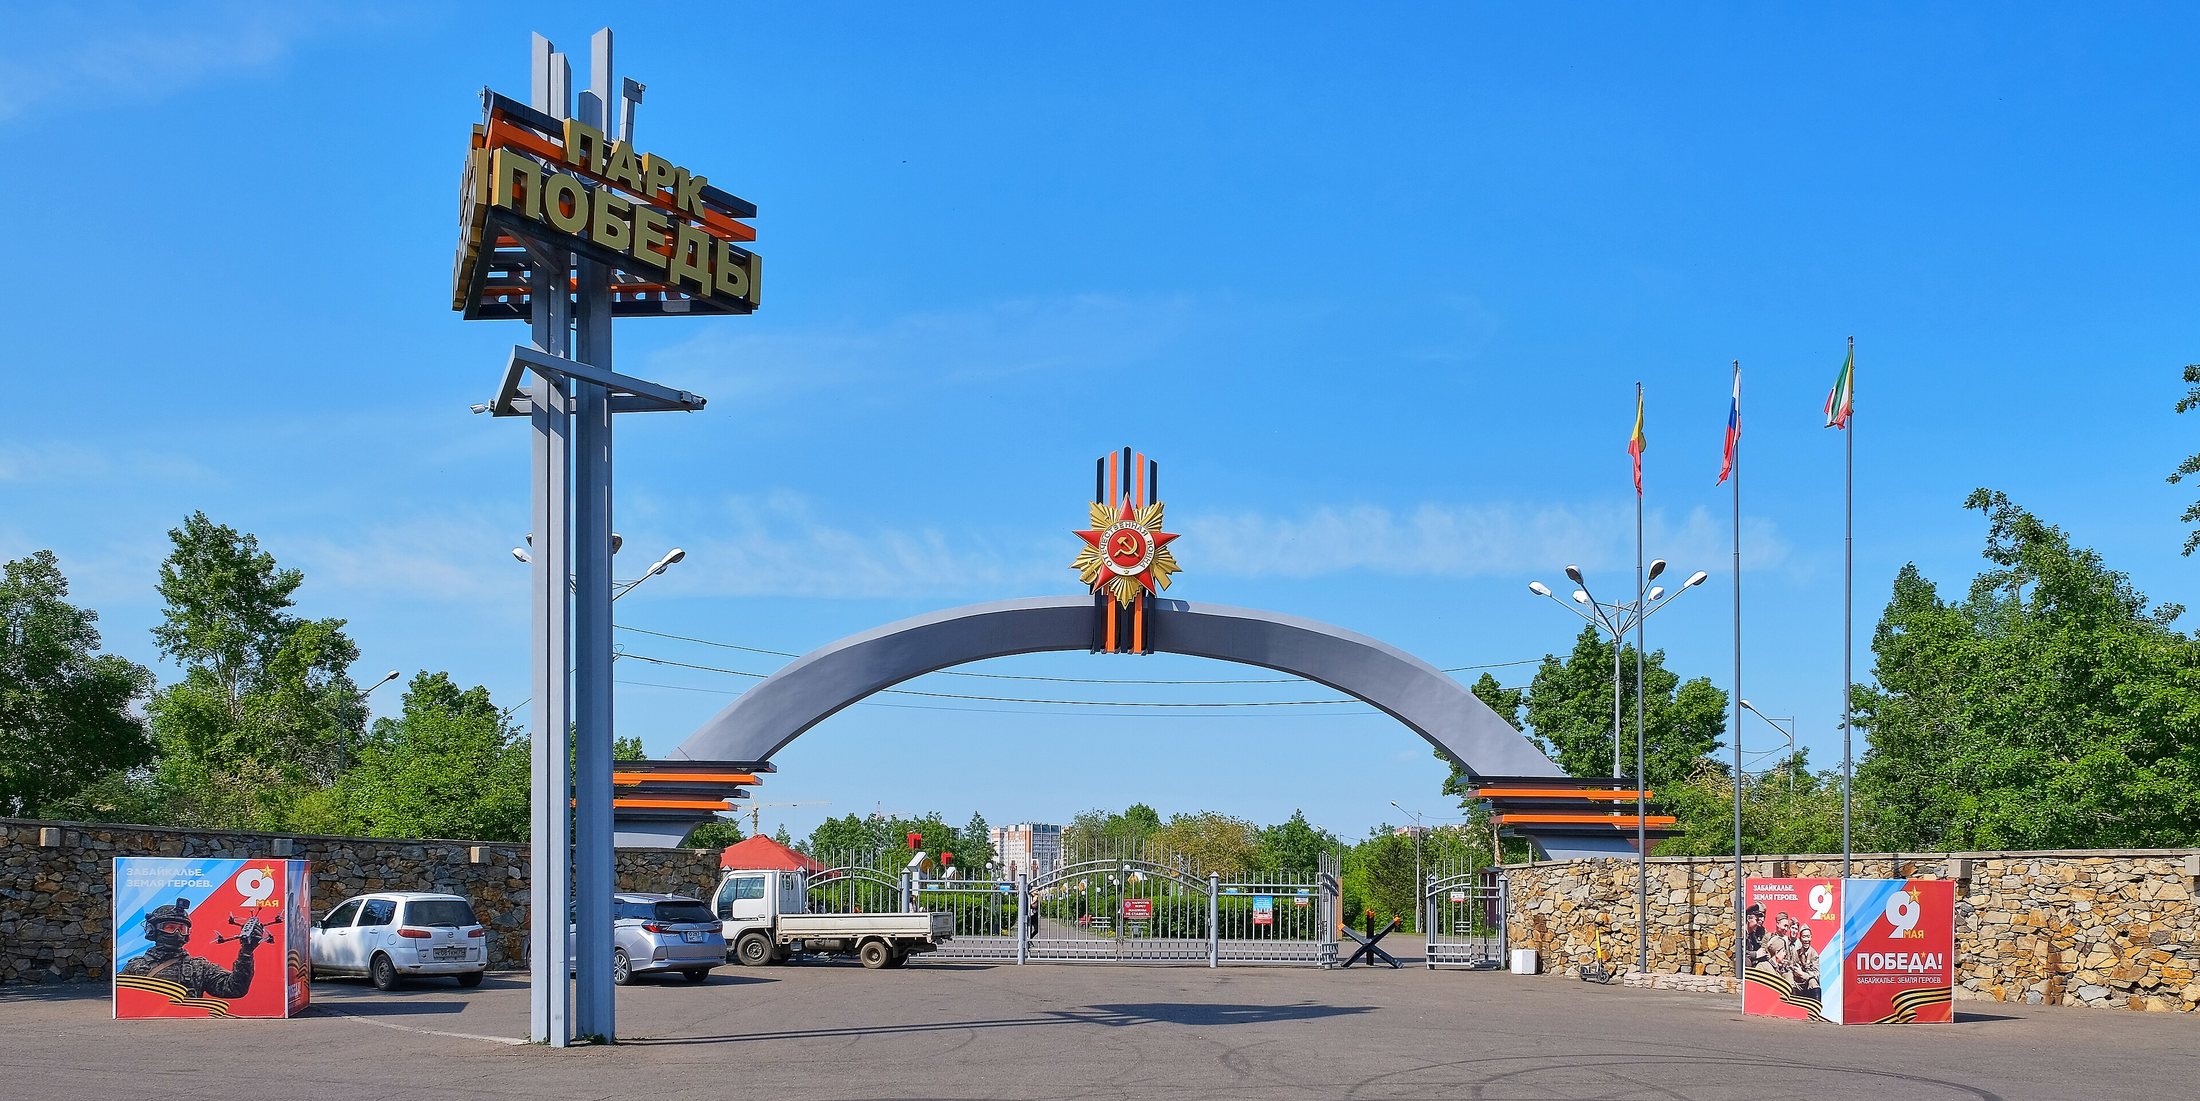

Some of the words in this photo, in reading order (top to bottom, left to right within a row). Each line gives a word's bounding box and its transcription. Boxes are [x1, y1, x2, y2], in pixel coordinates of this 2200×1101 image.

[563, 117, 708, 218] ПАРК
[492, 148, 762, 306] ПОБЕДЫ
[126, 867, 205, 877] ЗАБАЙКАЛЬЕ.
[127, 880, 165, 888] ЗЕМЛЯ
[167, 880, 213, 888] ГЕРОЕВ.
[235, 868, 275, 907] 9
[1753, 883, 1795, 892] ЗАБАЙКАЛЬЕ.
[1753, 893, 1773, 901] ЗЕМЛЯ
[1773, 893, 1799, 901] ГЕРОЕВ.
[1808, 884, 1833, 920] 9
[256, 899, 279, 907] МАЯ
[1821, 913, 1836, 921] МАЯ
[1885, 890, 1921, 939] 9
[1903, 929, 1924, 939] МАЯ
[1856, 952, 1943, 973] ПОБЕДА!
[1857, 976, 1897, 984] ЗАБАЙКАЛЬЕ.
